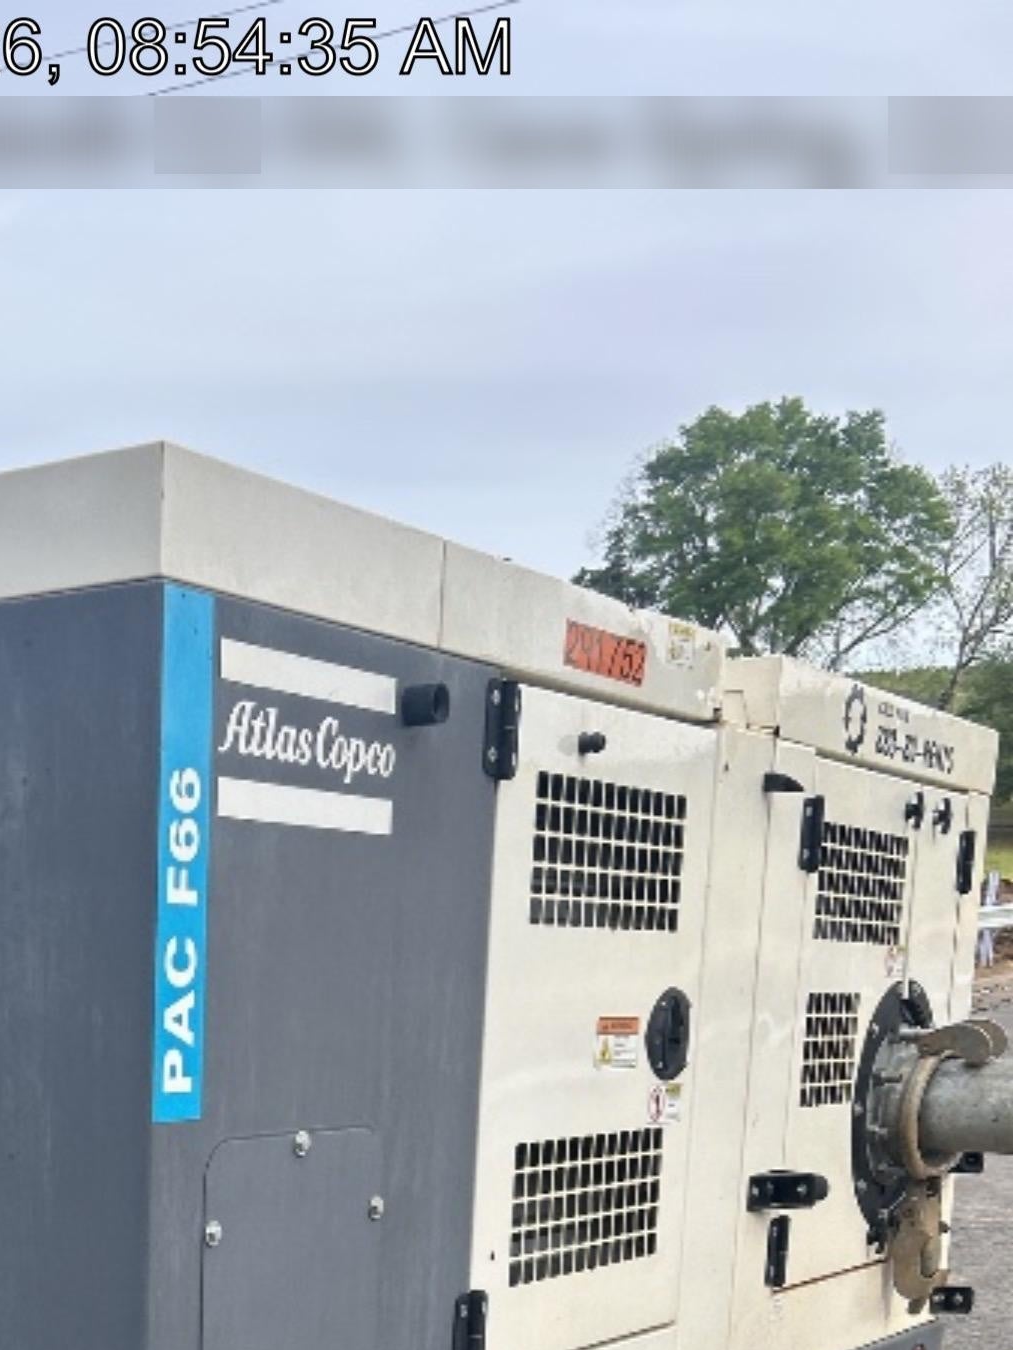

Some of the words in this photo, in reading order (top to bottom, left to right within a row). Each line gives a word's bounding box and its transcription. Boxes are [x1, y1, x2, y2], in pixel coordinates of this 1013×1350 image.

[218, 701, 313, 766] Atlas
[316, 716, 396, 784] Copco
[167, 767, 201, 907] F66
[162, 936, 197, 1093] PAC
